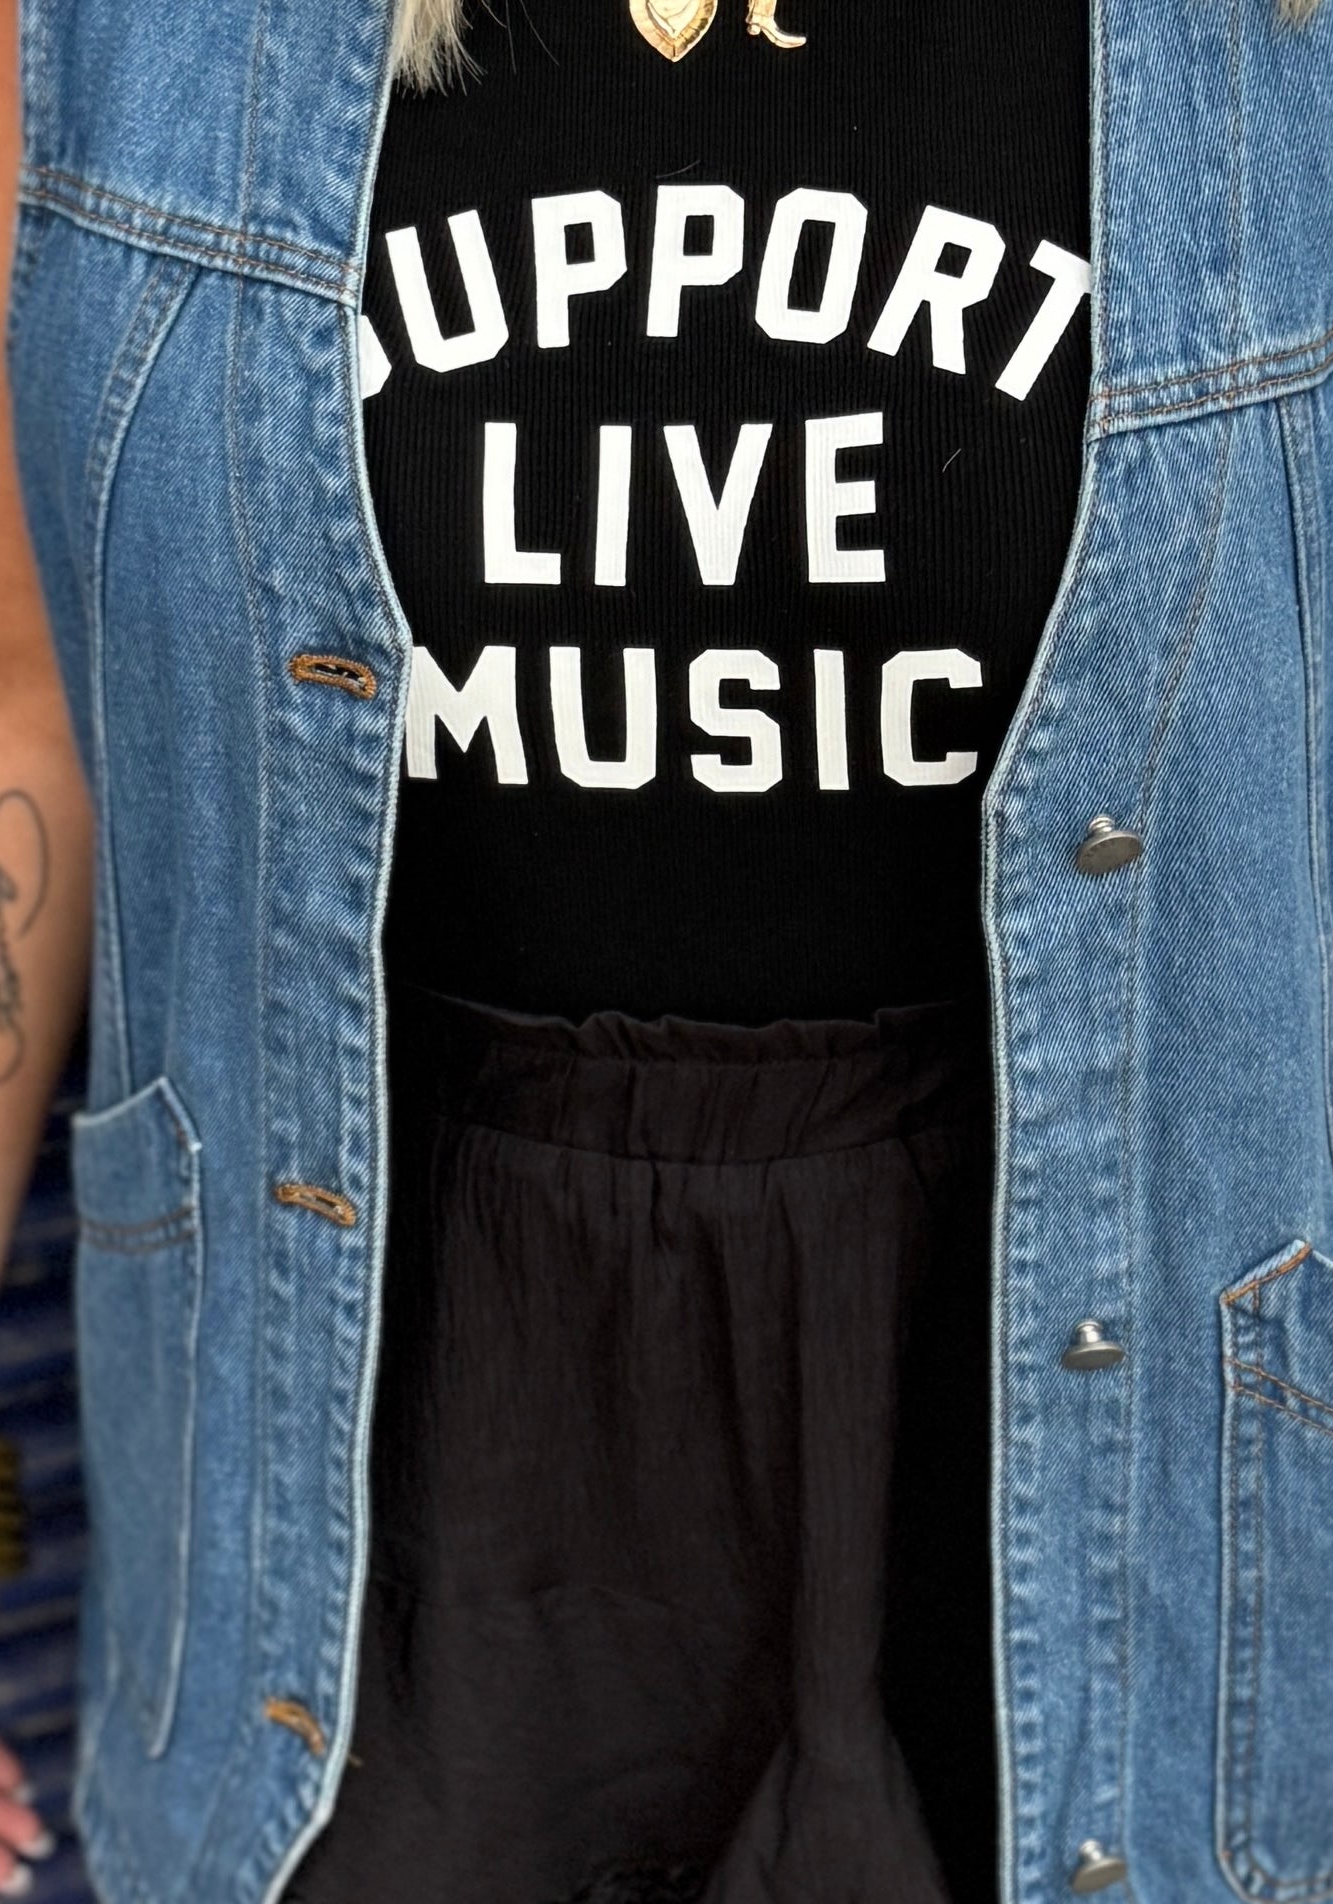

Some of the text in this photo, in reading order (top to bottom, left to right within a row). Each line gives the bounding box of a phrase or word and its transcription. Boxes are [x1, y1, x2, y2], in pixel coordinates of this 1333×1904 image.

[358, 183, 1093, 401] UPPORT
[482, 412, 886, 586] LIVE
[405, 645, 983, 793] MUSIC
